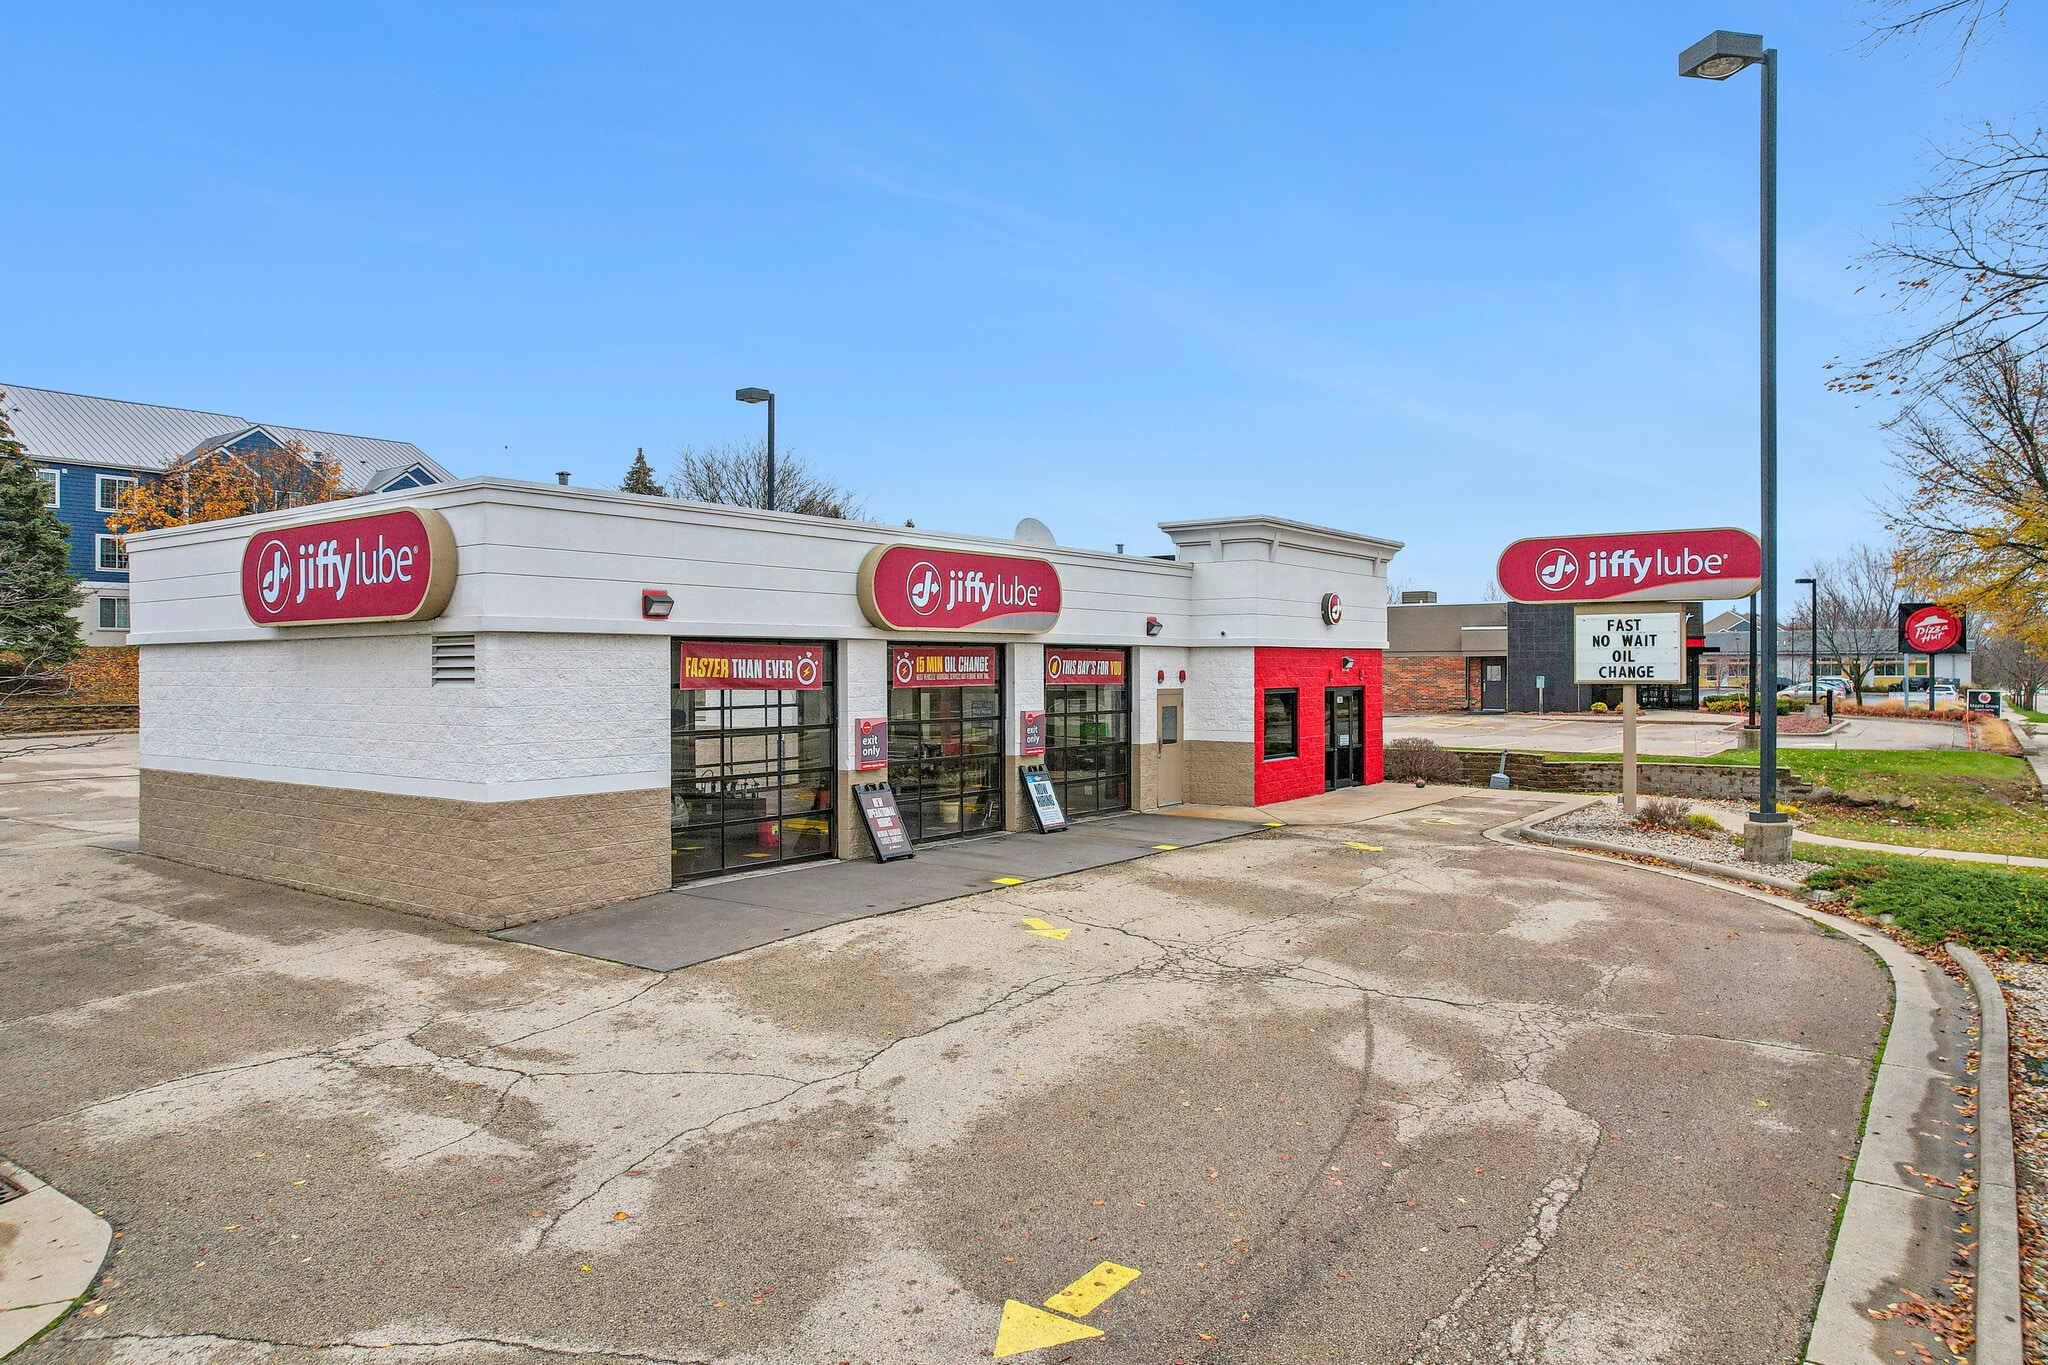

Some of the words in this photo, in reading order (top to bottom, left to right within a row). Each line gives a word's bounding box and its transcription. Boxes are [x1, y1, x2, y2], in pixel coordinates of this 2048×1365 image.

[296, 539, 352, 604] jiffy
[355, 534, 413, 586] lube
[1584, 549, 1652, 586] jiffy
[1656, 547, 1722, 576] lube
[946, 570, 995, 613] jiffy
[997, 574, 1038, 606] lube
[1607, 618, 1642, 632] FAST
[1915, 625, 1949, 639] Pizza
[1592, 635, 1610, 648] NO
[1622, 634, 1657, 647] WAIT
[1921, 631, 1944, 643] Hut
[1612, 650, 1635, 663] OIL
[685, 657, 729, 678] FASTER
[731, 659, 762, 679] THAN
[765, 659, 793, 679] EVER
[916, 656, 925, 673] 15
[926, 656, 943, 673] MIN
[944, 656, 957, 673] OIL
[958, 656, 989, 673] CHANGE
[1062, 660, 1076, 675] THIS
[1077, 660, 1097, 676] BAY'S
[1097, 661, 1109, 676] FOR
[1110, 661, 1122, 676] YOU
[1599, 665, 1655, 679] CHANGE
[1026, 725, 1038, 735] exit
[862, 735, 878, 746] exit
[1026, 734, 1040, 745] only
[862, 745, 881, 758] only
